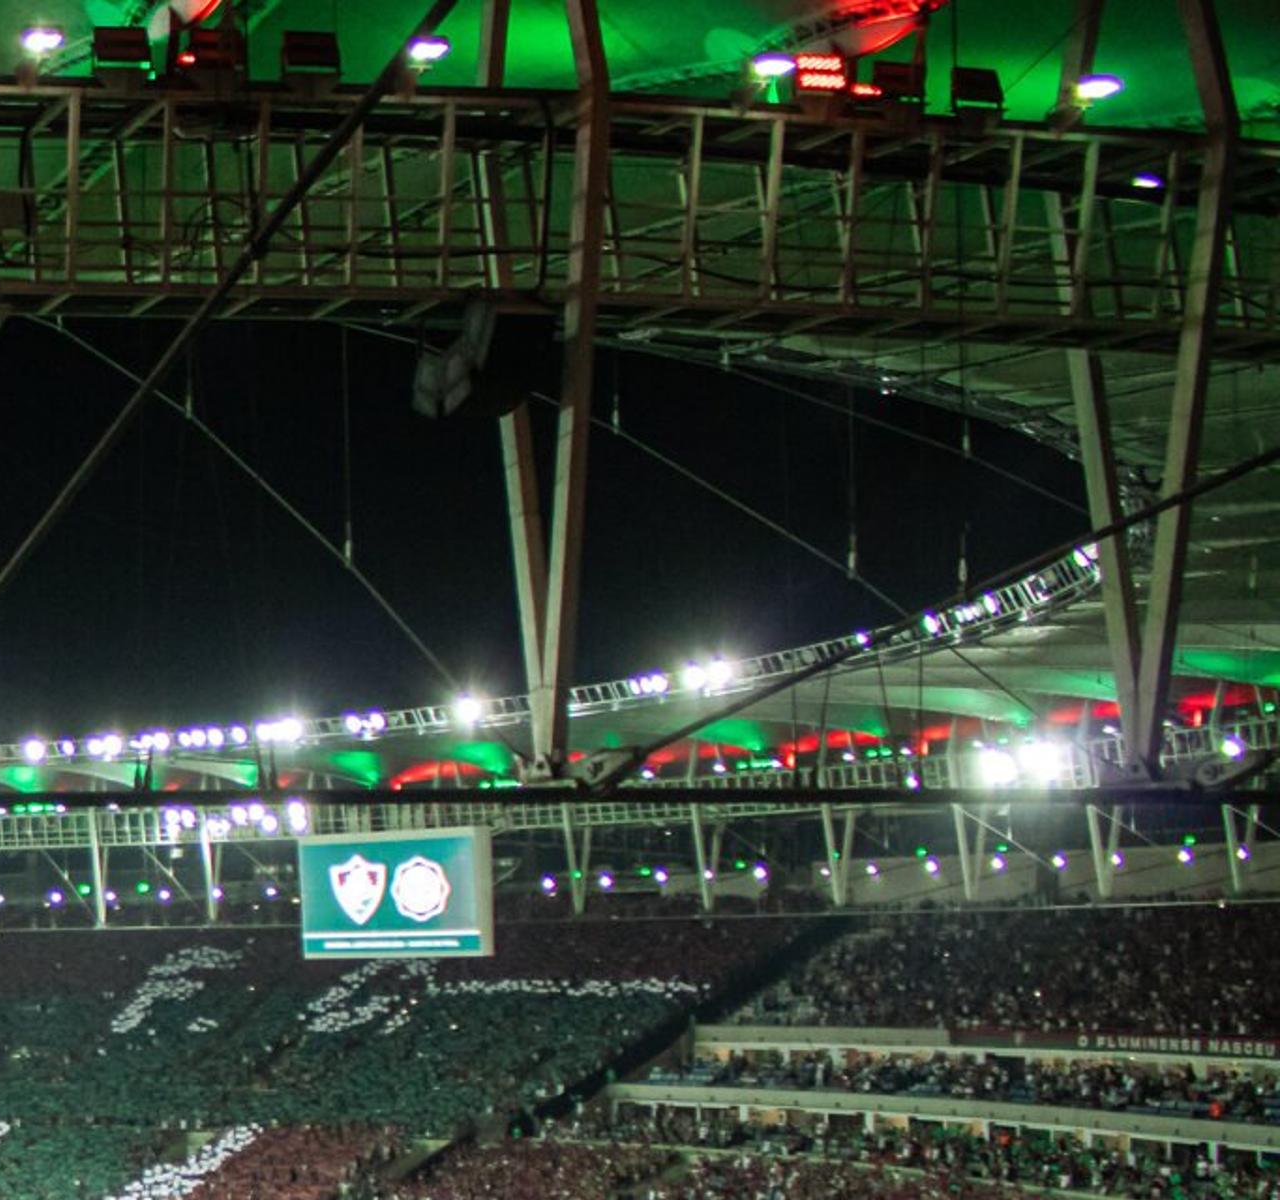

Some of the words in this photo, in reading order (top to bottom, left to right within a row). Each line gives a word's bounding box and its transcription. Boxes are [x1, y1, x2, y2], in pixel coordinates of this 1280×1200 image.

[1077, 1035, 1088, 1047] O
[1096, 1036, 1200, 1052] FLUMINENSE
[1208, 1040, 1276, 1057] NASCEU
